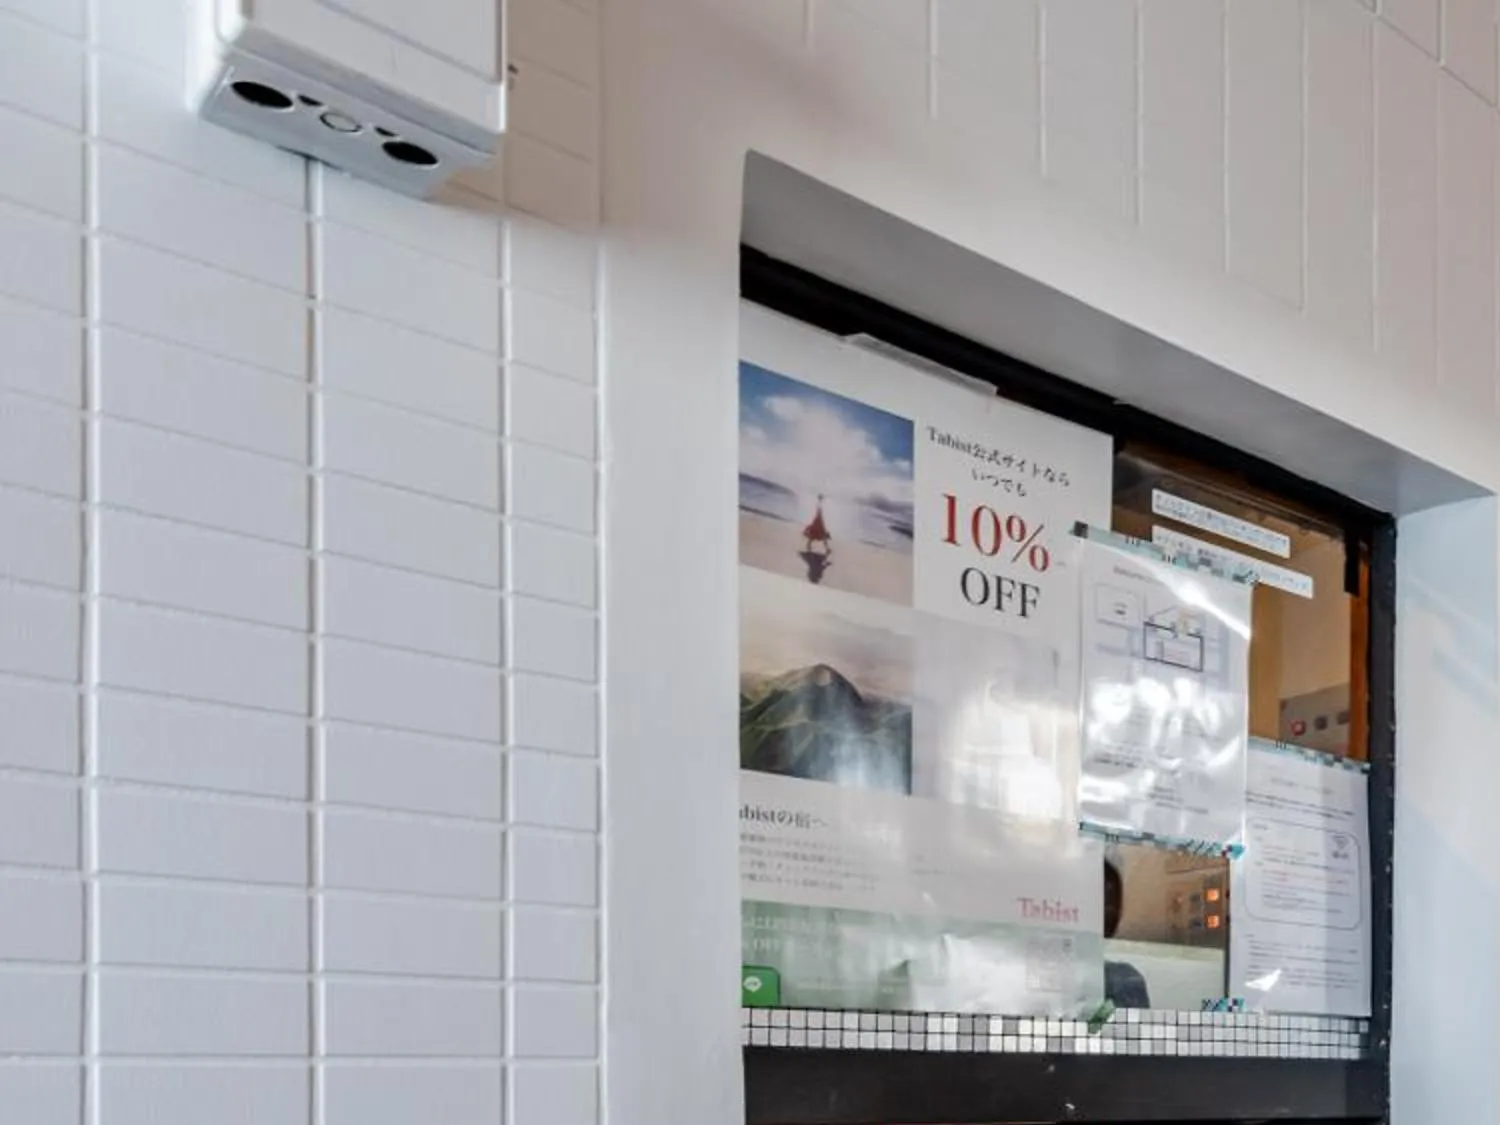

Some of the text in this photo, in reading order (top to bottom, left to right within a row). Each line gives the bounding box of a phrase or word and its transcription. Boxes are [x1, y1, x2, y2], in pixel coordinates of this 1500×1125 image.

[971, 468, 1027, 497] いつでも
[941, 493, 1050, 573] 10%
[960, 566, 1040, 619] OFF
[1016, 897, 1081, 923] Tabist
